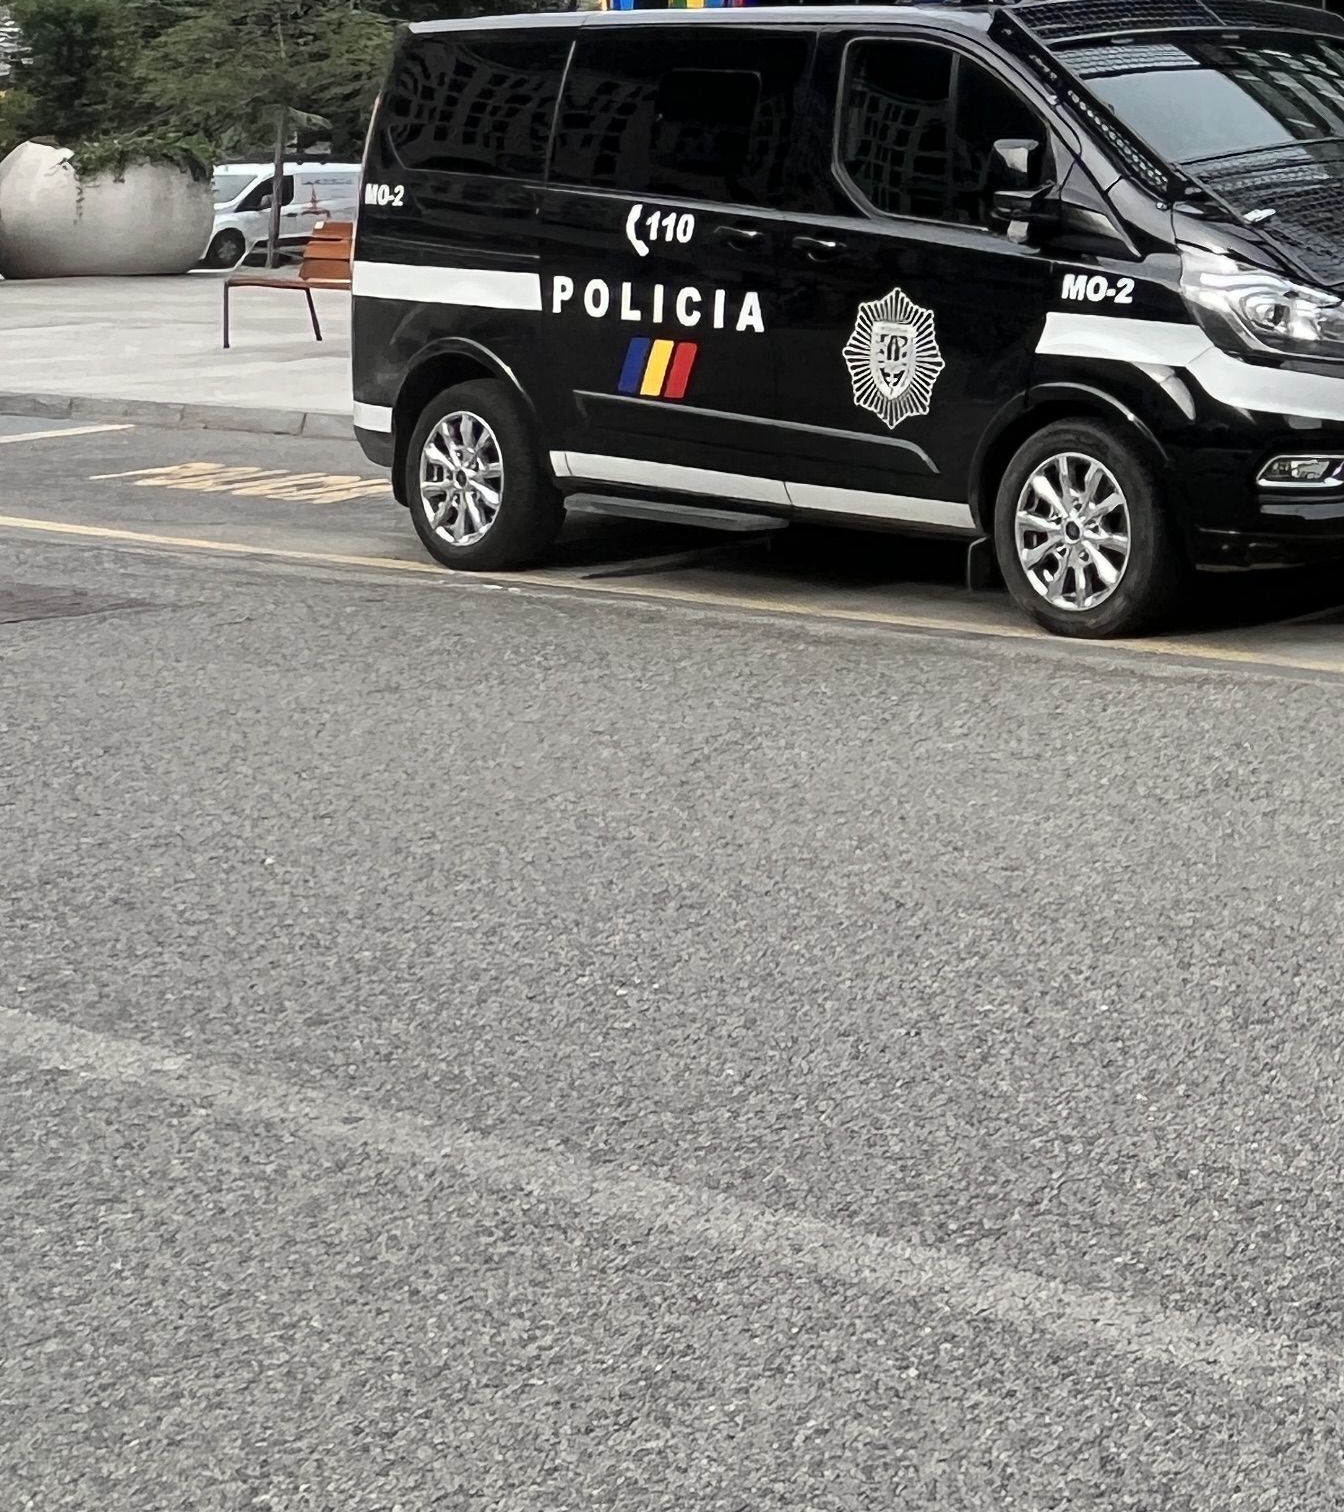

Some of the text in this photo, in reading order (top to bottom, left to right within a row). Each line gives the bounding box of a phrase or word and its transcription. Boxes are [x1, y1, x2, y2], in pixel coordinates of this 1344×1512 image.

[364, 182, 405, 207] MO-2
[645, 210, 695, 244] 110
[551, 274, 765, 334] POLICIA
[1061, 273, 1135, 304] MO-2
